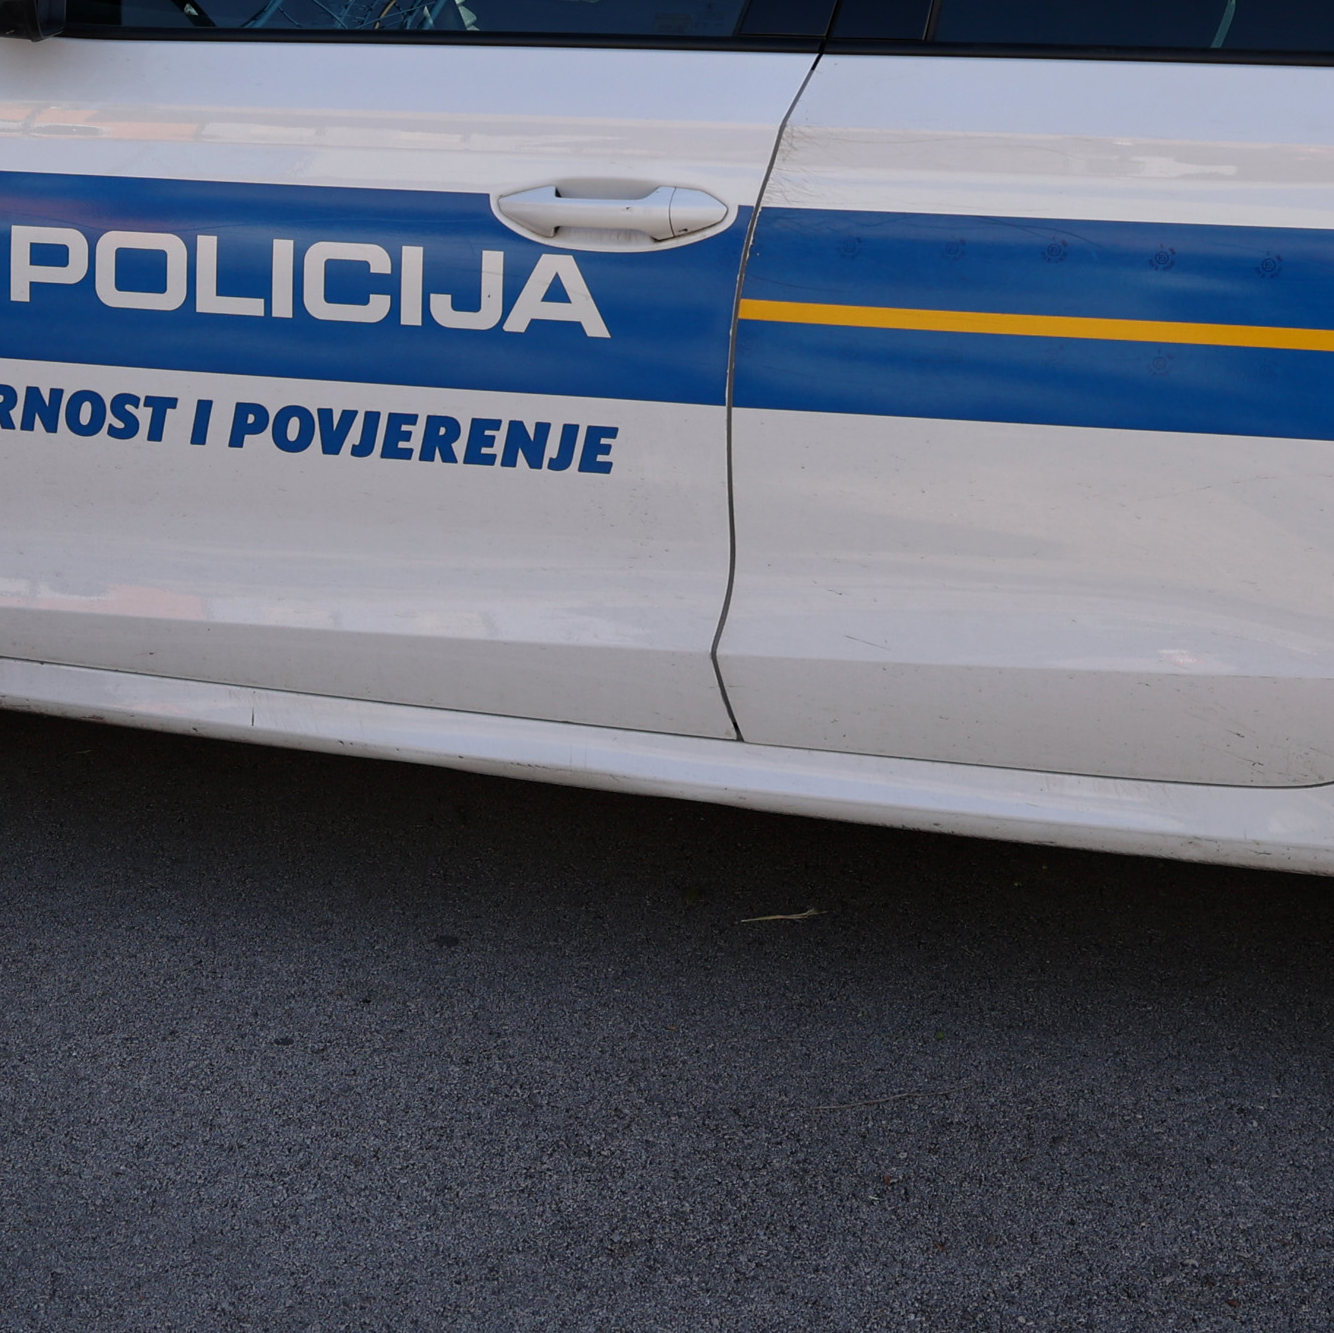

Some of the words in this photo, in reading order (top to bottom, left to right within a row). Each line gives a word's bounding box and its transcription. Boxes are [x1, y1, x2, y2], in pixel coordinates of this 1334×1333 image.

[10, 225, 611, 338] POLICIJA
[190, 399, 213, 445] I
[228, 402, 619, 474] POVJERENJE
